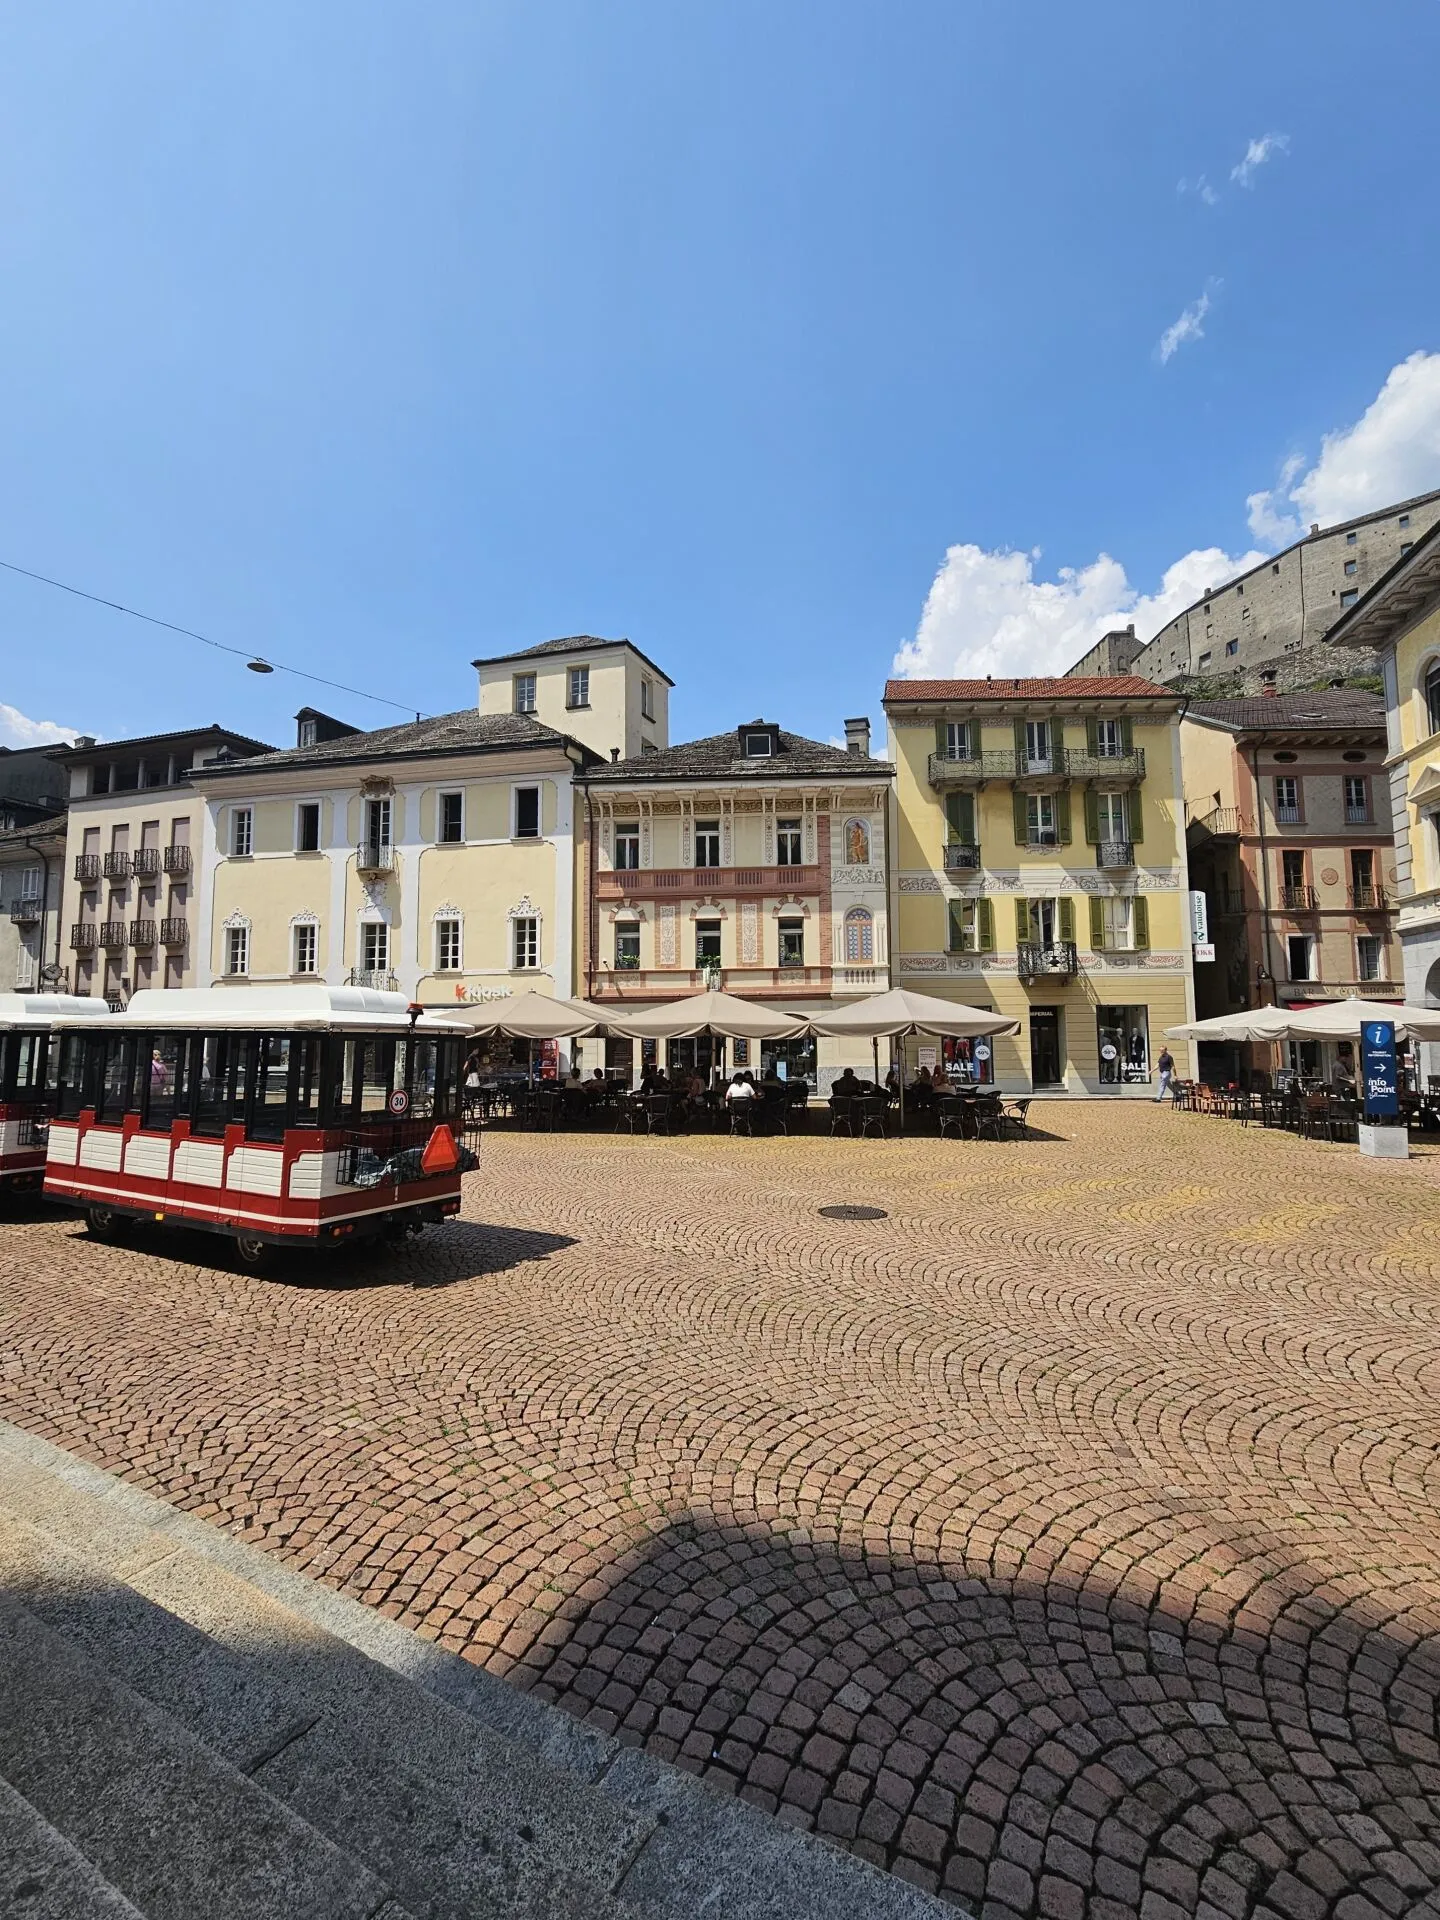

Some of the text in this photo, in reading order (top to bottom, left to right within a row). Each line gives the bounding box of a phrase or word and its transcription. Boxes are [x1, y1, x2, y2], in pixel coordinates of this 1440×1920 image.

[1194, 895, 1204, 930] vaudoise
[1293, 988, 1315, 996] BAR
[945, 1062, 974, 1072] SALE
[1120, 1062, 1148, 1070] SALE
[1368, 1077, 1387, 1086] info
[1371, 1085, 1397, 1094] Point
[394, 1096, 404, 1106] 30
